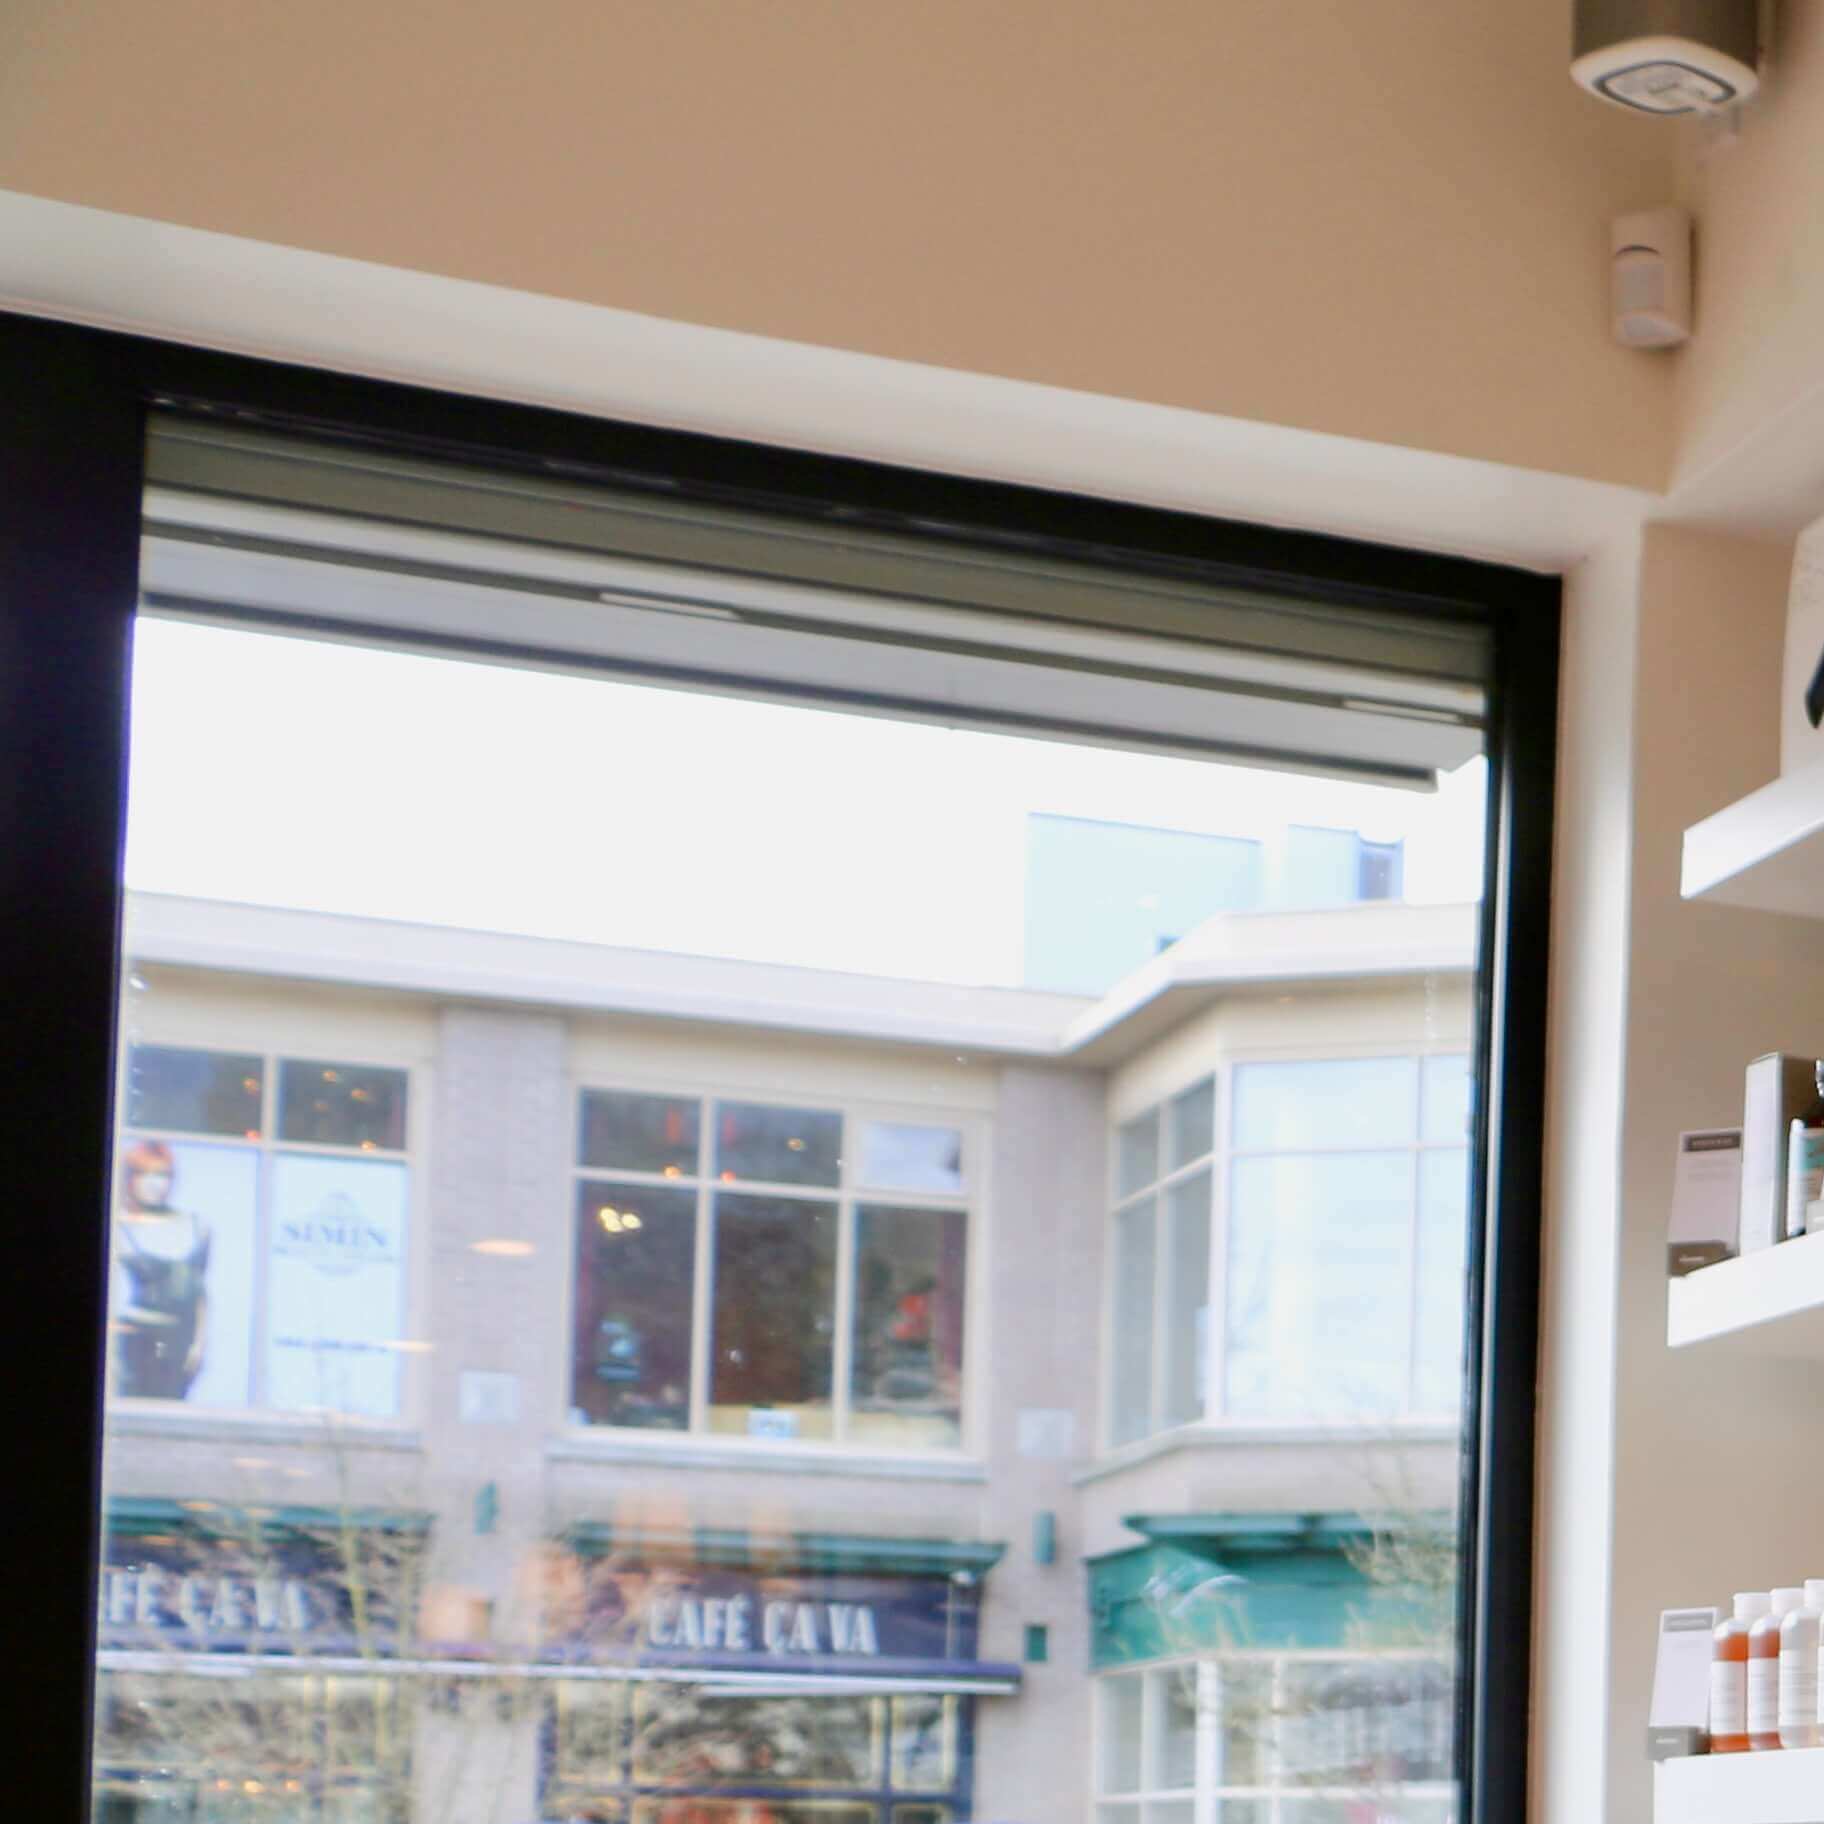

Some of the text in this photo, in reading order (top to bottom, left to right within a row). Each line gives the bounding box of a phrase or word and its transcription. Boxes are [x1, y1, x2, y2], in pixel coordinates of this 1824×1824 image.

[648, 1592, 880, 1660] CAFÉ ÇA VA
